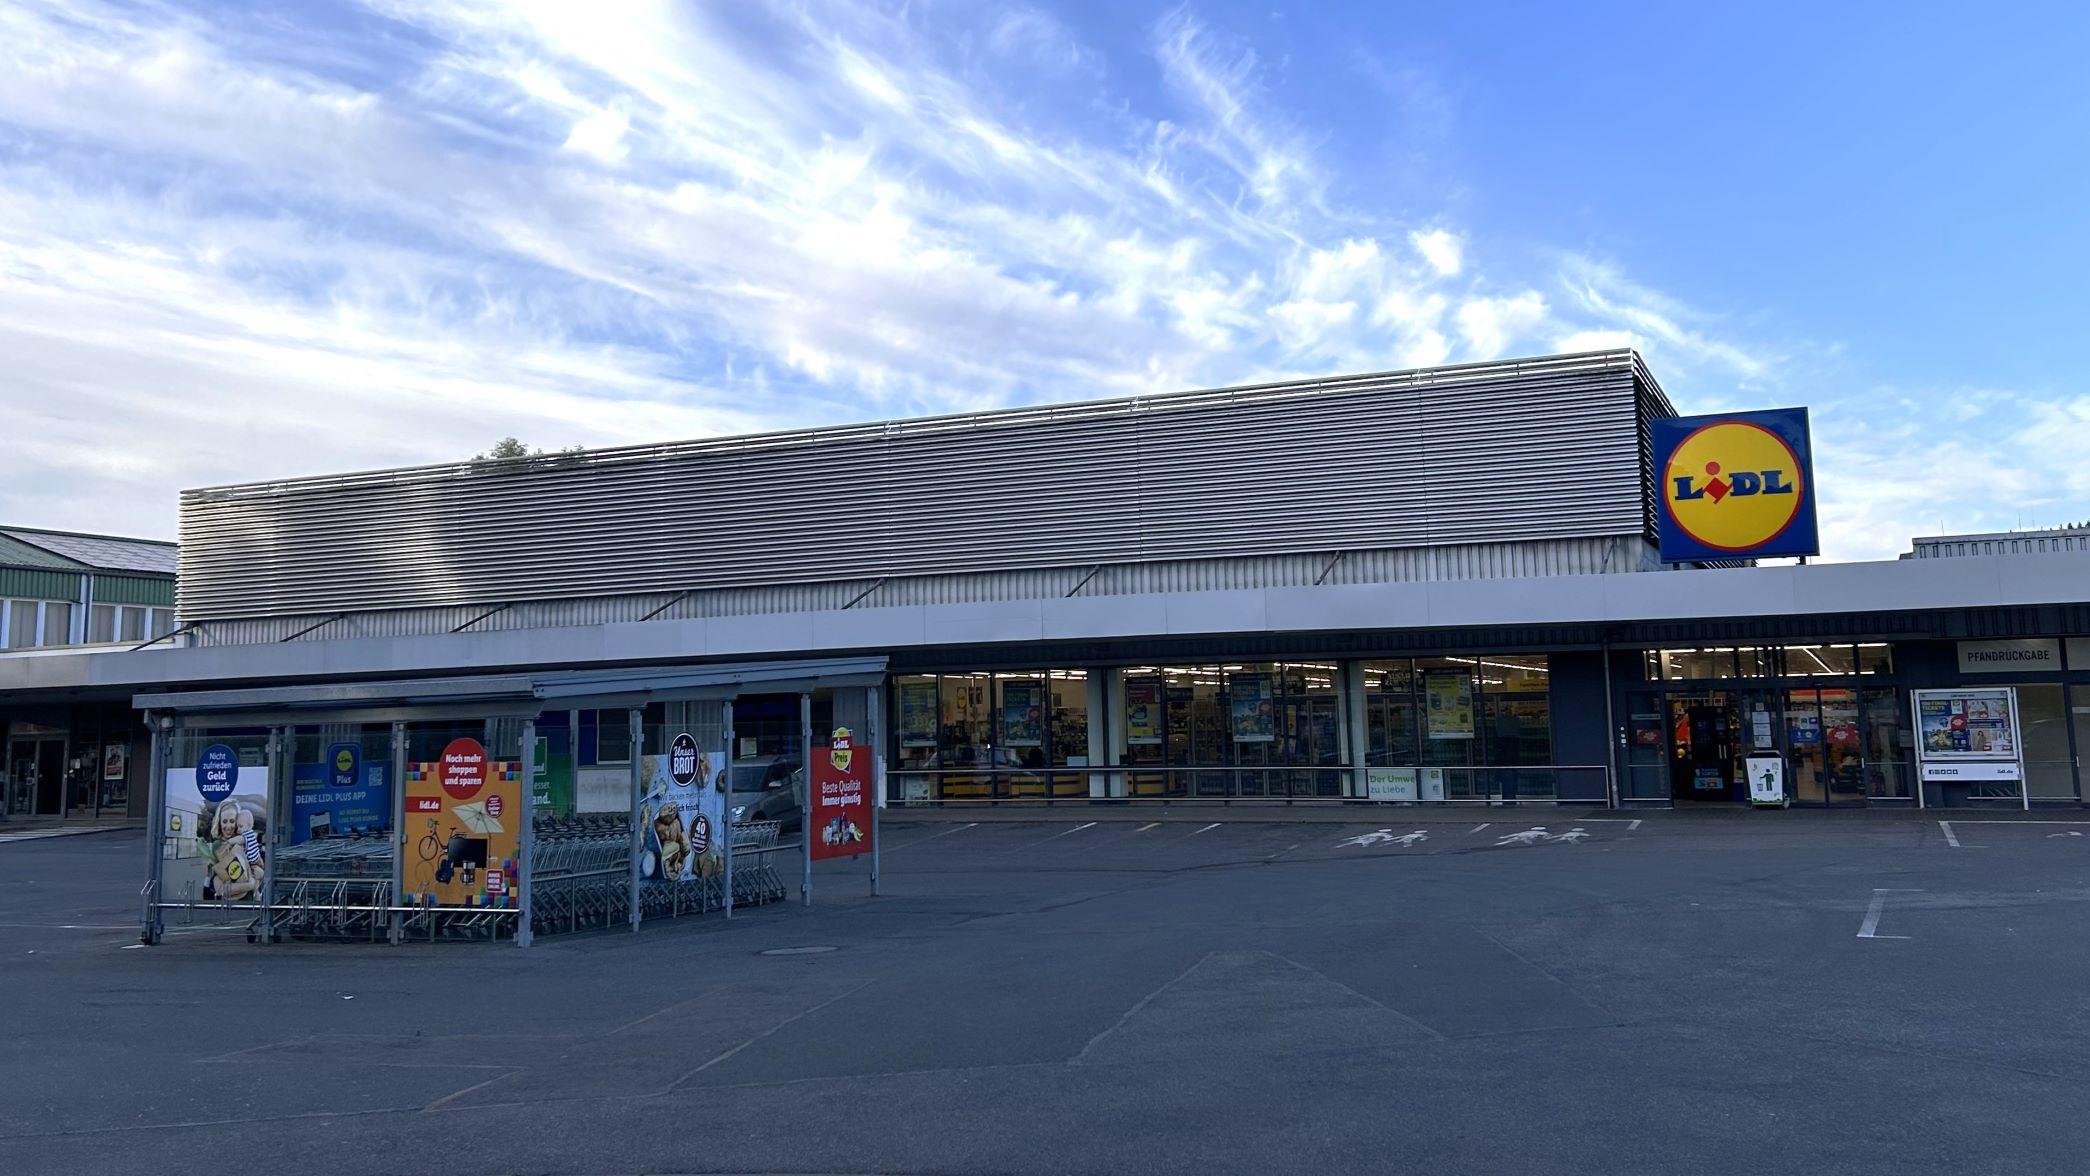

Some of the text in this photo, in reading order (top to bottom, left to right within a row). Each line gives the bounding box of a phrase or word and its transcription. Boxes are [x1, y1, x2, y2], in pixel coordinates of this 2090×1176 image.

[1673, 461, 1793, 505] LIDL
[209, 752, 226, 760] Nicht
[673, 745, 695, 757] Unser
[445, 754, 481, 763] Noch mehr
[834, 752, 848, 763] Preis
[203, 761, 232, 770] zufrieden
[448, 765, 478, 775] shoppen
[673, 756, 695, 775] BROT
[206, 770, 227, 781] Geld
[336, 775, 352, 784] Plus
[1369, 775, 1386, 783] Der
[202, 781, 231, 792] zurück
[444, 776, 482, 787] und sparen
[822, 779, 861, 795] Beste Qualität
[1370, 784, 1406, 794] zu Liebe
[295, 791, 366, 804] DEINE LIDL PLUS APP
[822, 792, 861, 807] Immer günstig
[419, 800, 440, 810] lidl.de
[695, 821, 706, 835] 40
